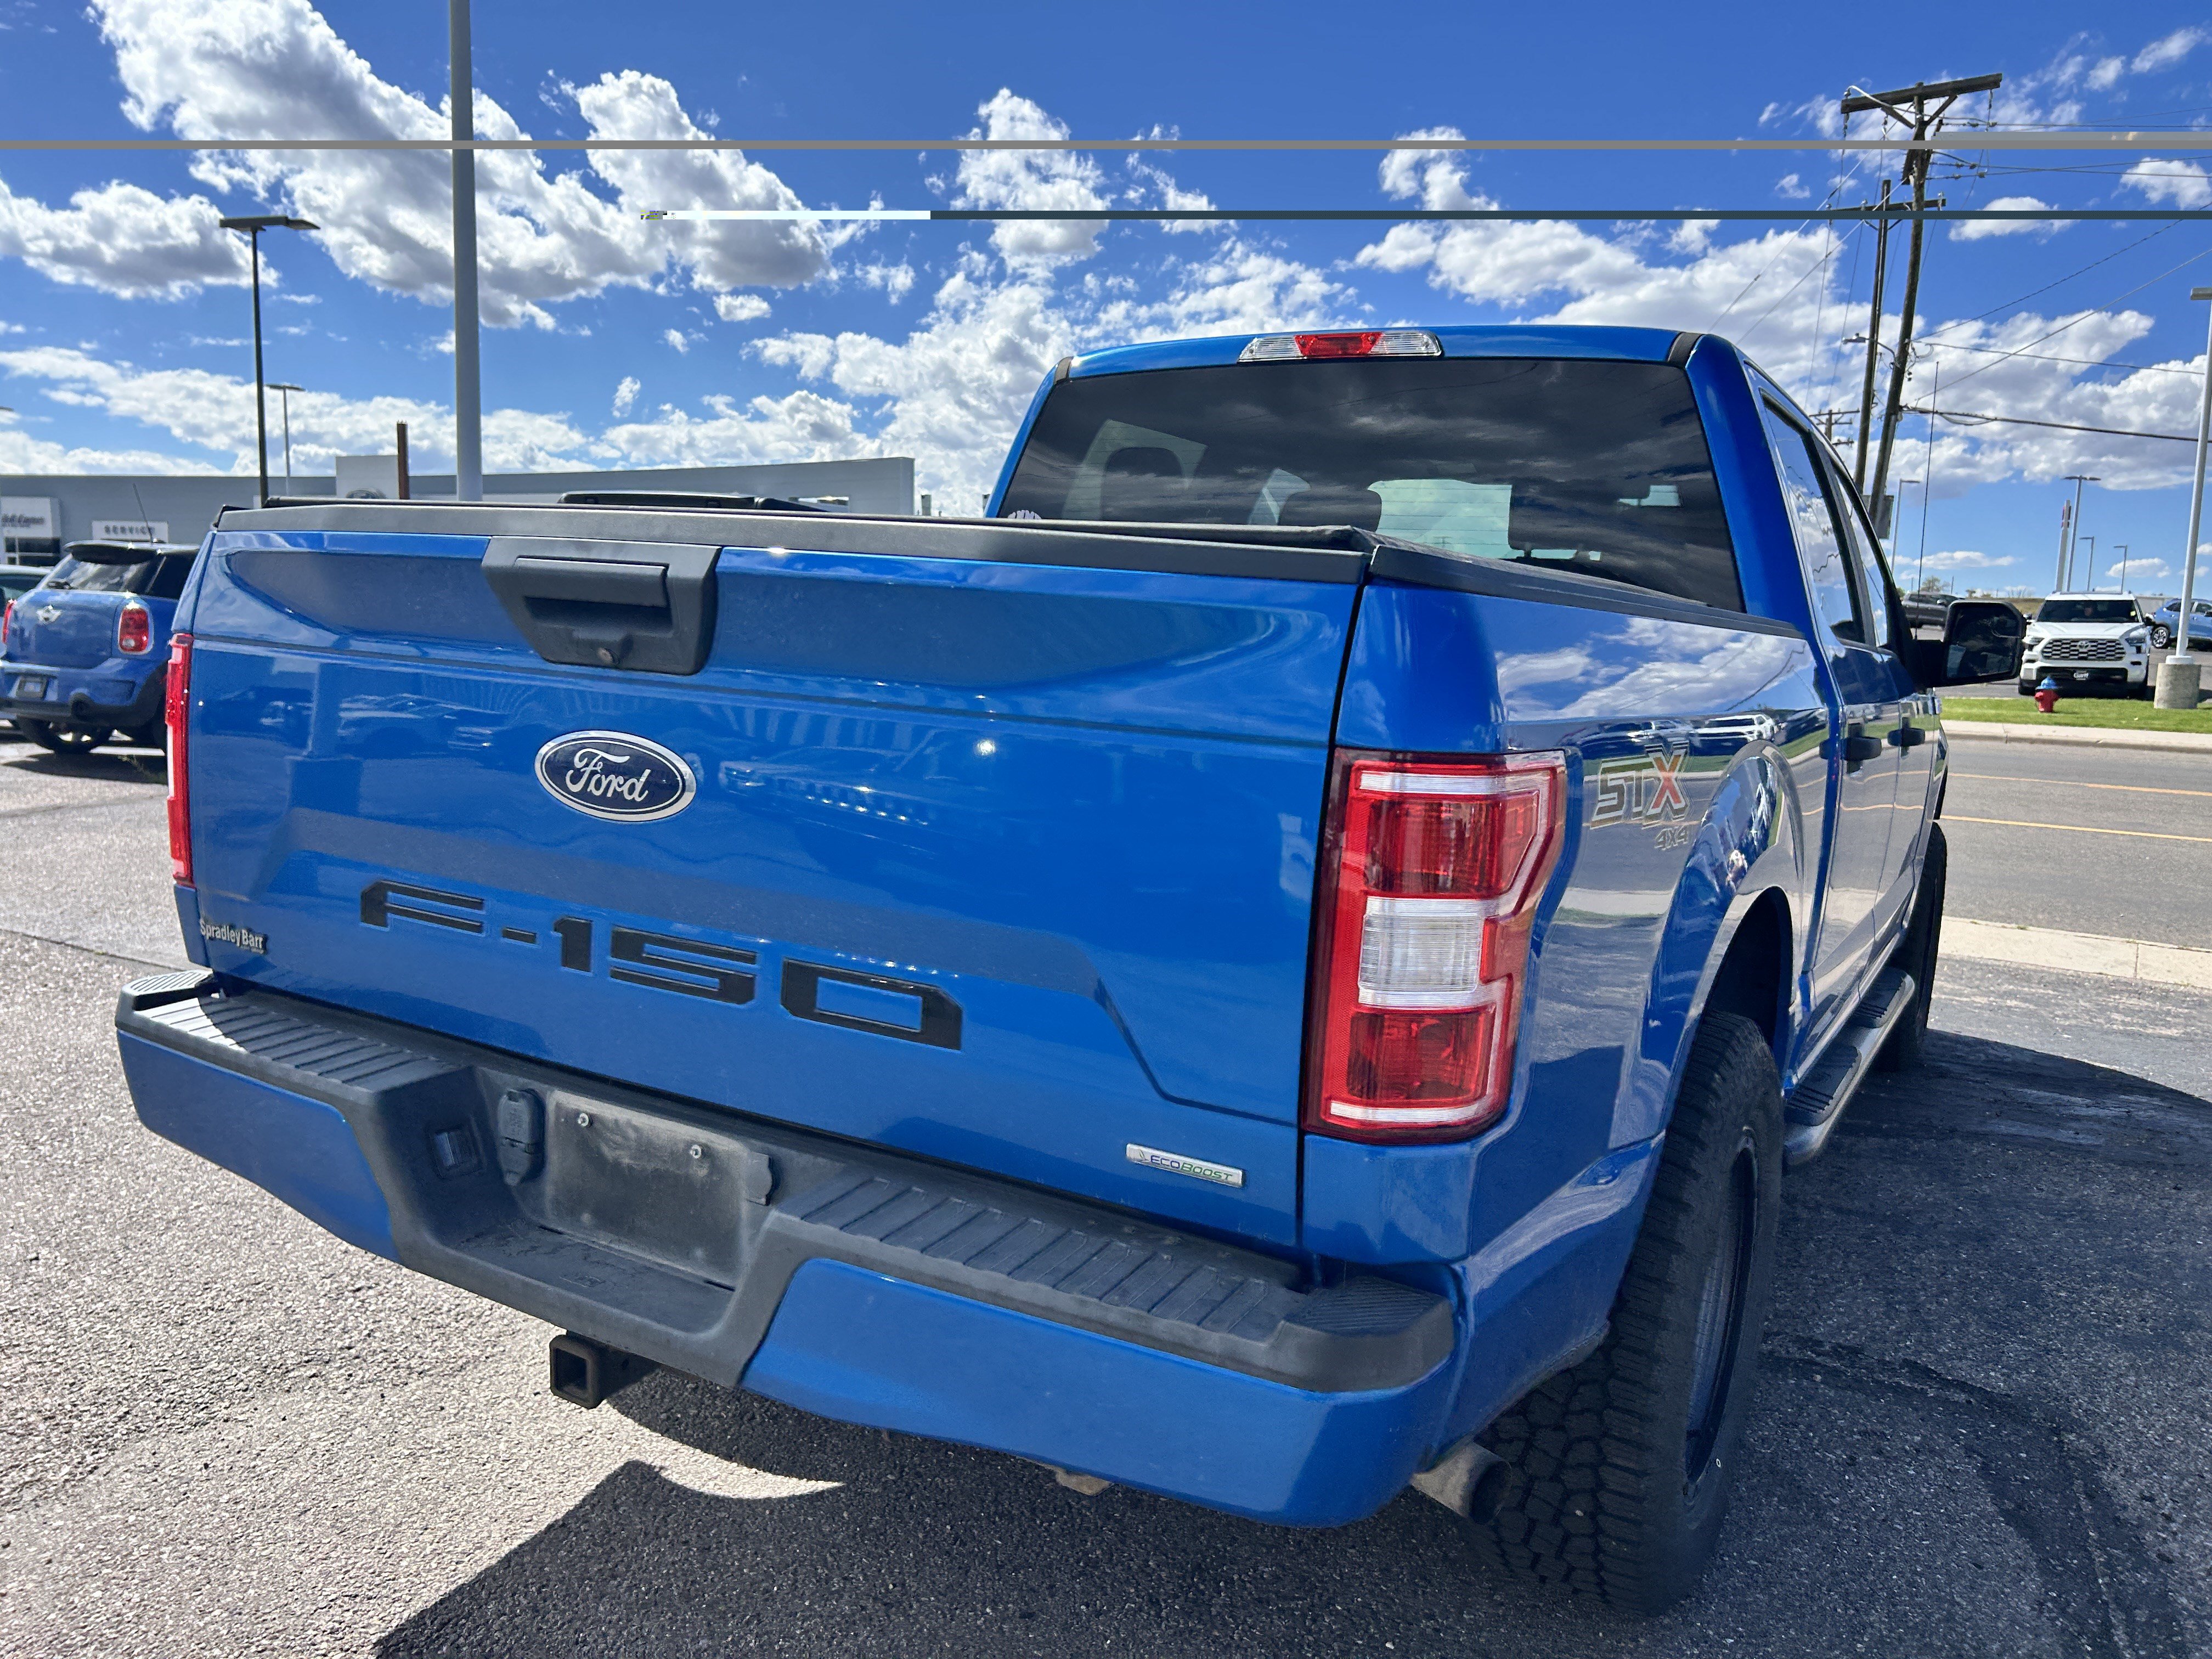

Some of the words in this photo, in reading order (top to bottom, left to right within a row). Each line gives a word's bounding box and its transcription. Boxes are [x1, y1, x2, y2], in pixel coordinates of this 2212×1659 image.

[565, 747, 651, 802] Ford
[1589, 738, 1690, 830] STX
[359, 879, 963, 1052] F-150
